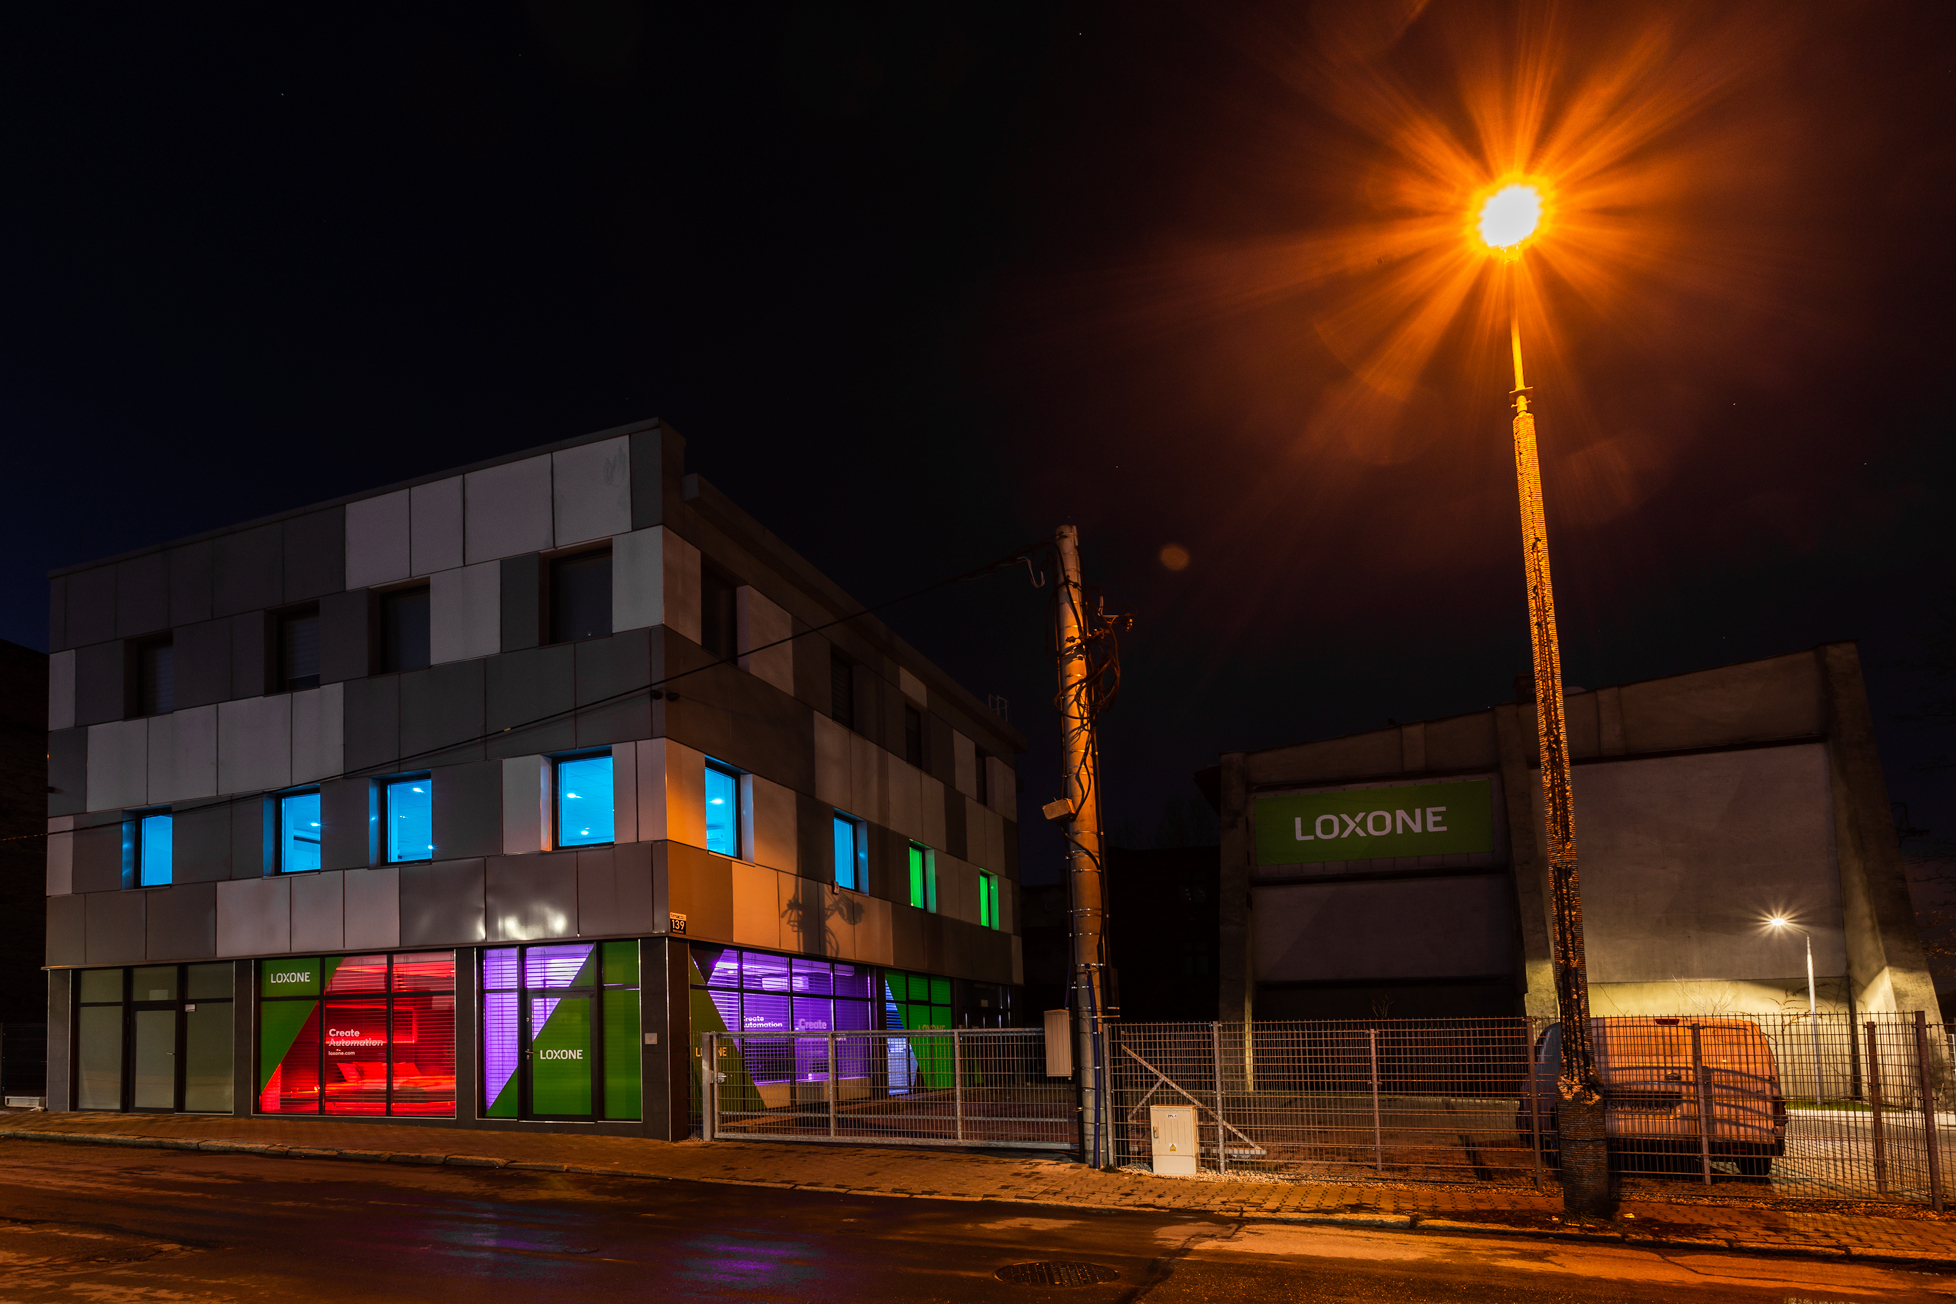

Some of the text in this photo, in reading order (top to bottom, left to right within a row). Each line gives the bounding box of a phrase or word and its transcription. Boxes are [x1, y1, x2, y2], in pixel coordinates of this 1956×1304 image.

[1295, 806, 1447, 841] LOXONE
[672, 919, 685, 930] 139
[270, 972, 311, 983] LOXONE
[799, 1018, 827, 1029] Create
[328, 1028, 360, 1037] Create
[328, 1038, 384, 1047] Automation
[540, 1049, 584, 1060] LOXONE
